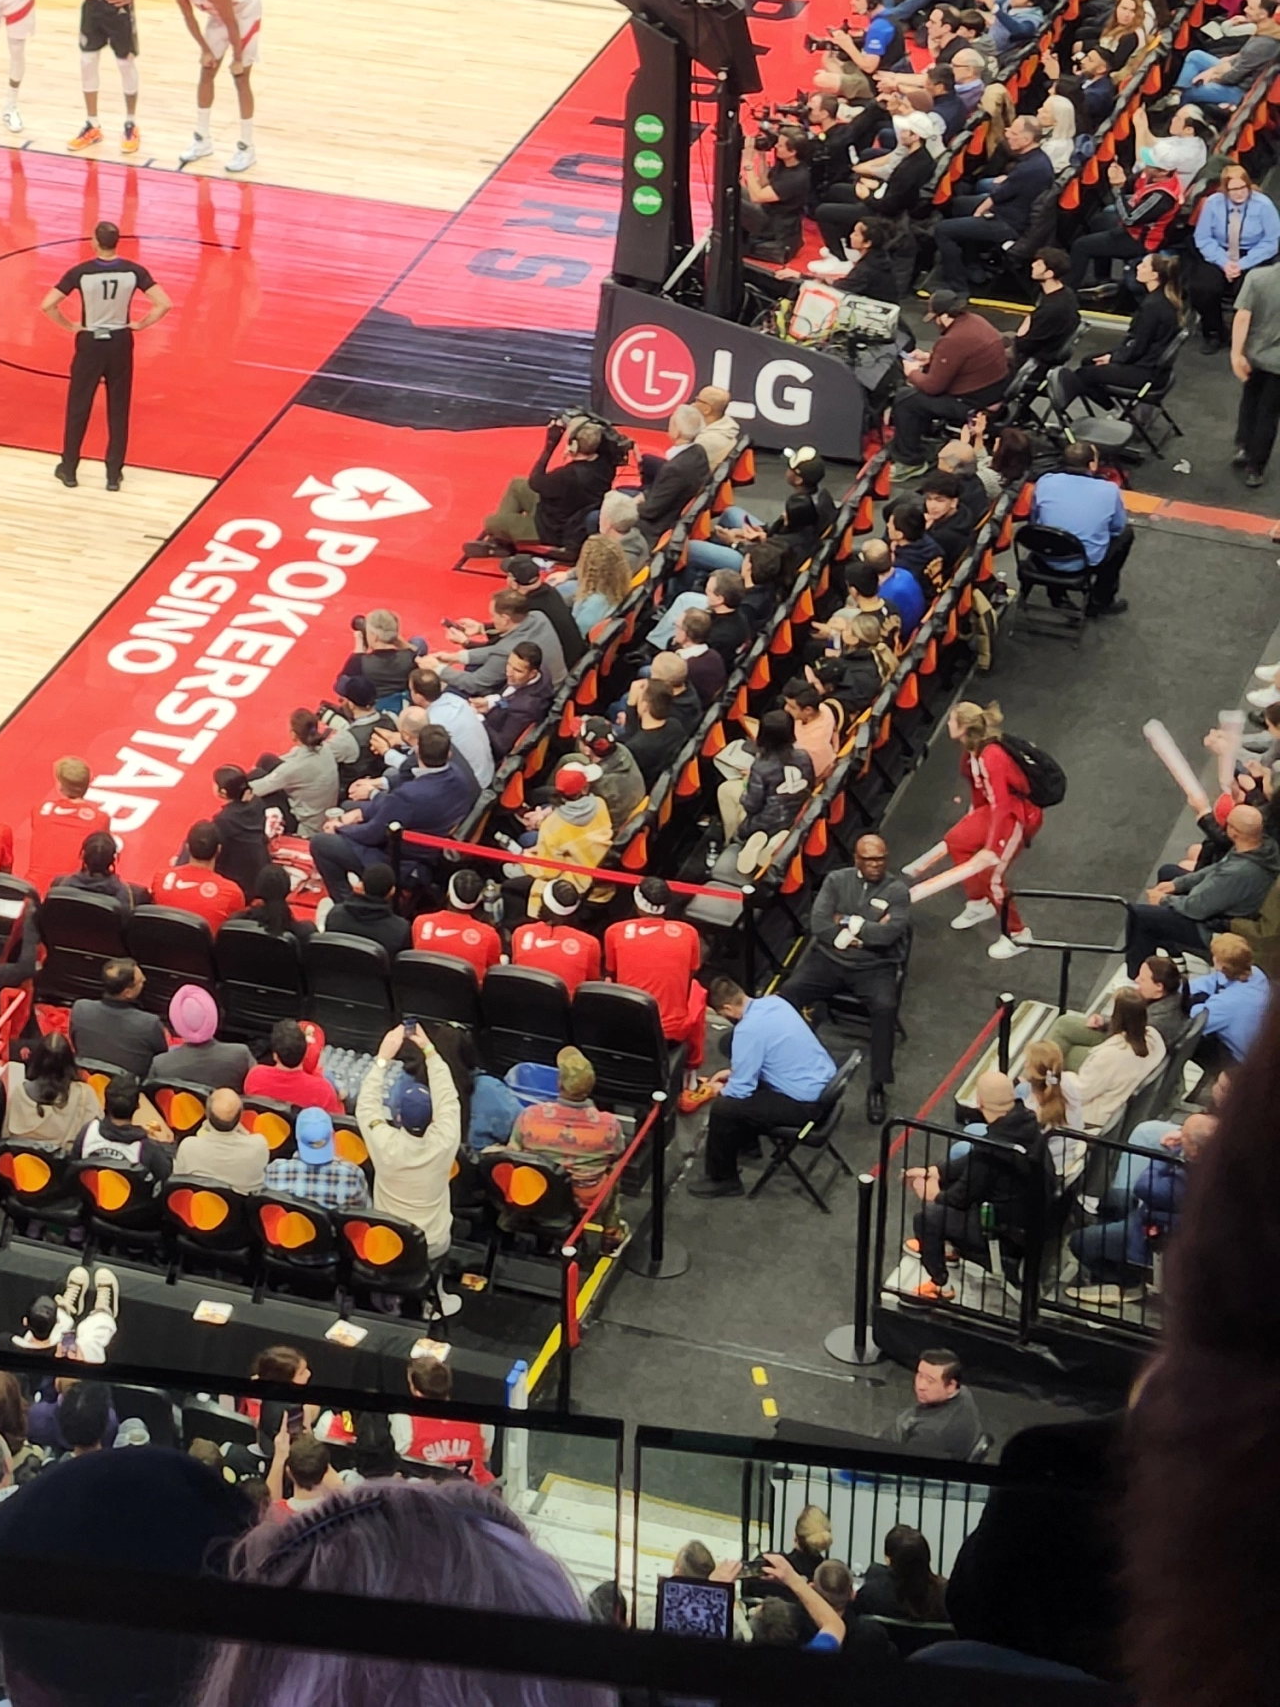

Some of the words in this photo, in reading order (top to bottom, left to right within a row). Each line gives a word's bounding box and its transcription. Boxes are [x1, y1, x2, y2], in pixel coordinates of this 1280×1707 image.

[102, 279, 119, 300] 17
[711, 349, 814, 426] LG
[107, 518, 282, 674] CASINO
[86, 528, 380, 852] POKERSTAR
[422, 1438, 471, 1462] SIAKAM
